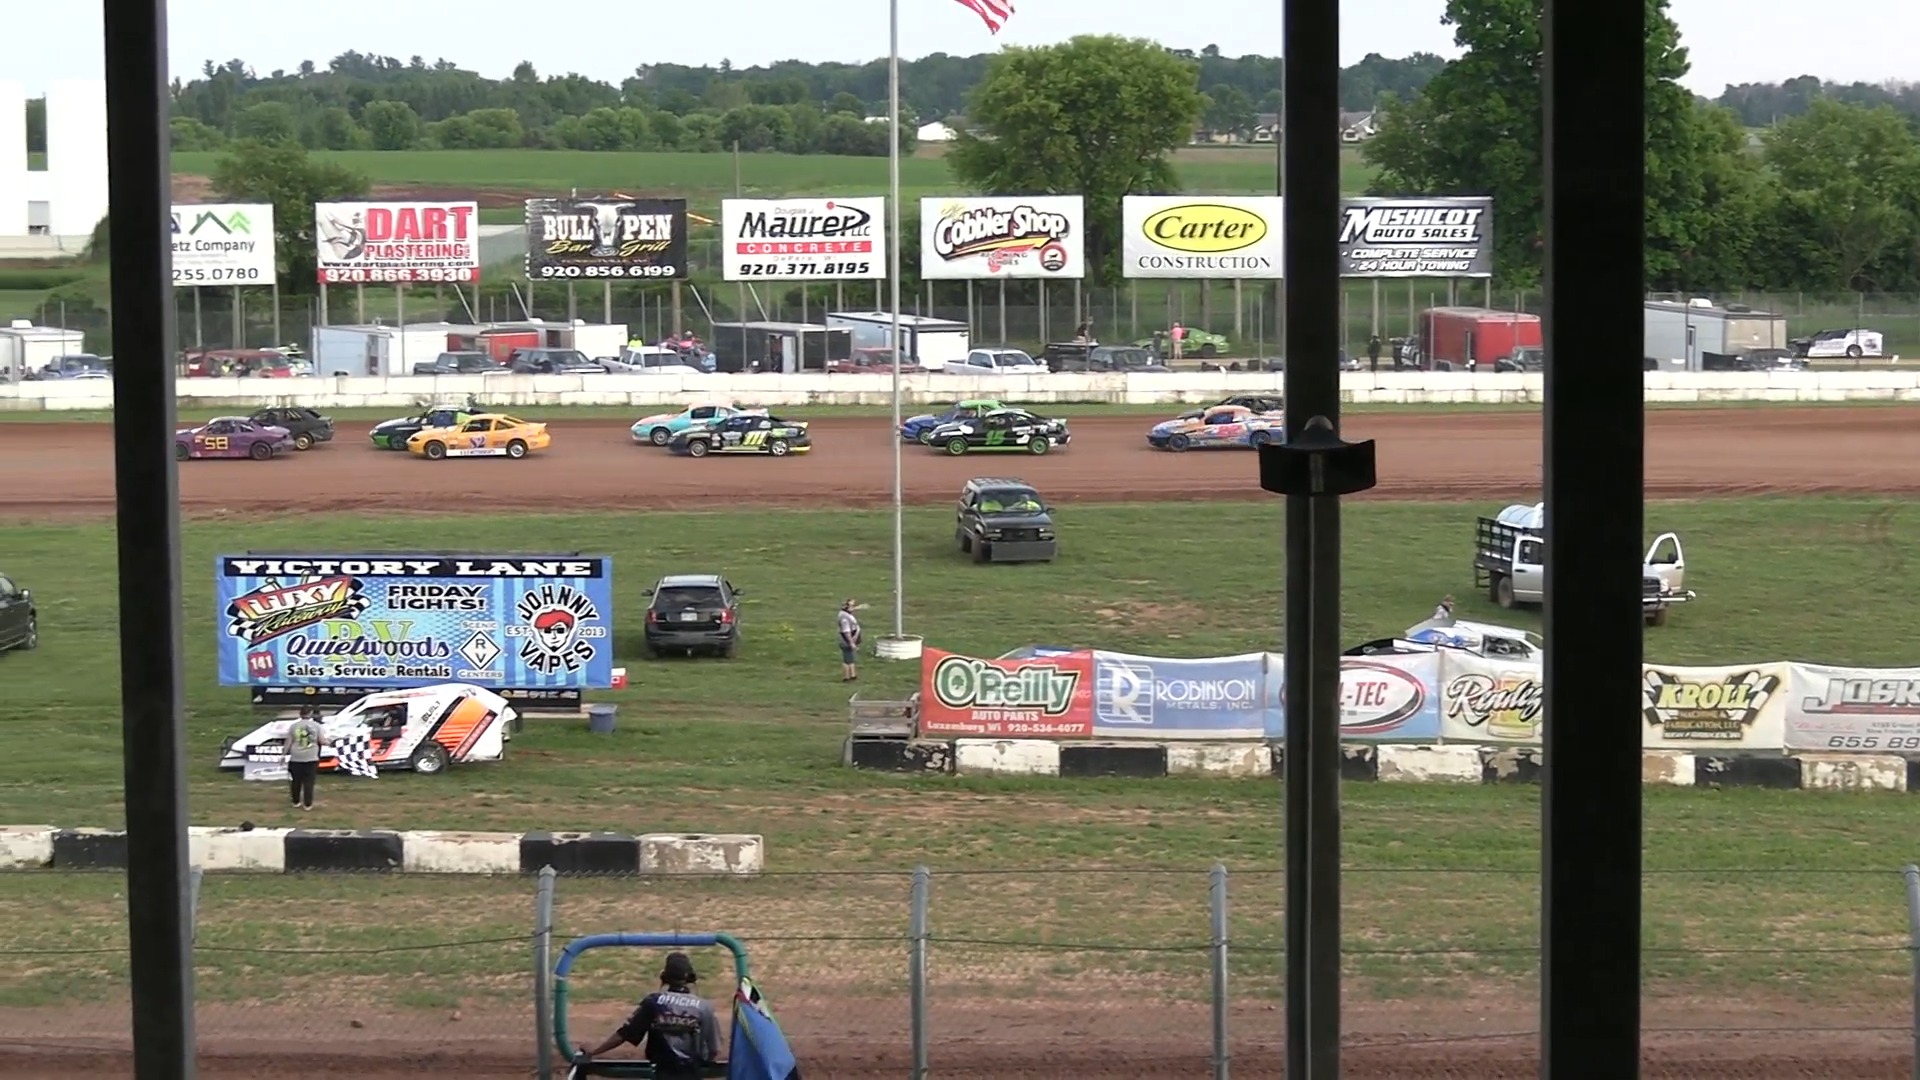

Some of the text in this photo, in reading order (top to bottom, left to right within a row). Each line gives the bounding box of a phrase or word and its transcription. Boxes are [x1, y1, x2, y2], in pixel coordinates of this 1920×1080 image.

[365, 206, 473, 241] DART
[542, 214, 673, 241] BULL PEN
[739, 211, 871, 238] Maurer LLC
[935, 205, 1066, 256] Cobbler Shop
[1154, 215, 1254, 239] Carter
[1339, 208, 1482, 242] MISHICOT
[1373, 228, 1469, 238] AUTO SALES
[195, 240, 256, 253] Company
[365, 243, 464, 260] PLASTERING
[545, 240, 672, 257] Bar Grill
[746, 242, 862, 253] CONCRETE
[1351, 248, 1478, 259] COMPLETE SERVICE
[323, 260, 475, 268] www.dartplastering.com
[739, 262, 870, 275] 920.371.8195
[1138, 256, 1271, 269] CONSTRUCTION
[1358, 261, 1470, 271] 24 HOUR TOWING
[325, 268, 472, 282] 920.866.3930
[231, 560, 591, 576] VICTORY LANE
[247, 580, 344, 615] LUXY
[388, 586, 483, 597] FRIDAY
[388, 599, 486, 610] LIGHTS!
[517, 585, 598, 620] JOHNNY
[578, 627, 605, 637] 2013
[286, 635, 450, 658] Quietwoods
[475, 638, 486, 649] R
[250, 655, 274, 671] 141
[475, 653, 486, 663] V
[520, 640, 594, 673] VAPES
[287, 664, 451, 678] Sales Service Rentals
[938, 659, 1072, 710] O'Reilly
[1156, 679, 1256, 701] ROBINSON
[1656, 683, 1751, 709] KROLL
[971, 711, 1039, 721] AUTO PARTS
[927, 721, 985, 733] Luxemburg
[1828, 736, 1879, 748] 655
[657, 994, 700, 1009] OFFICIAL
